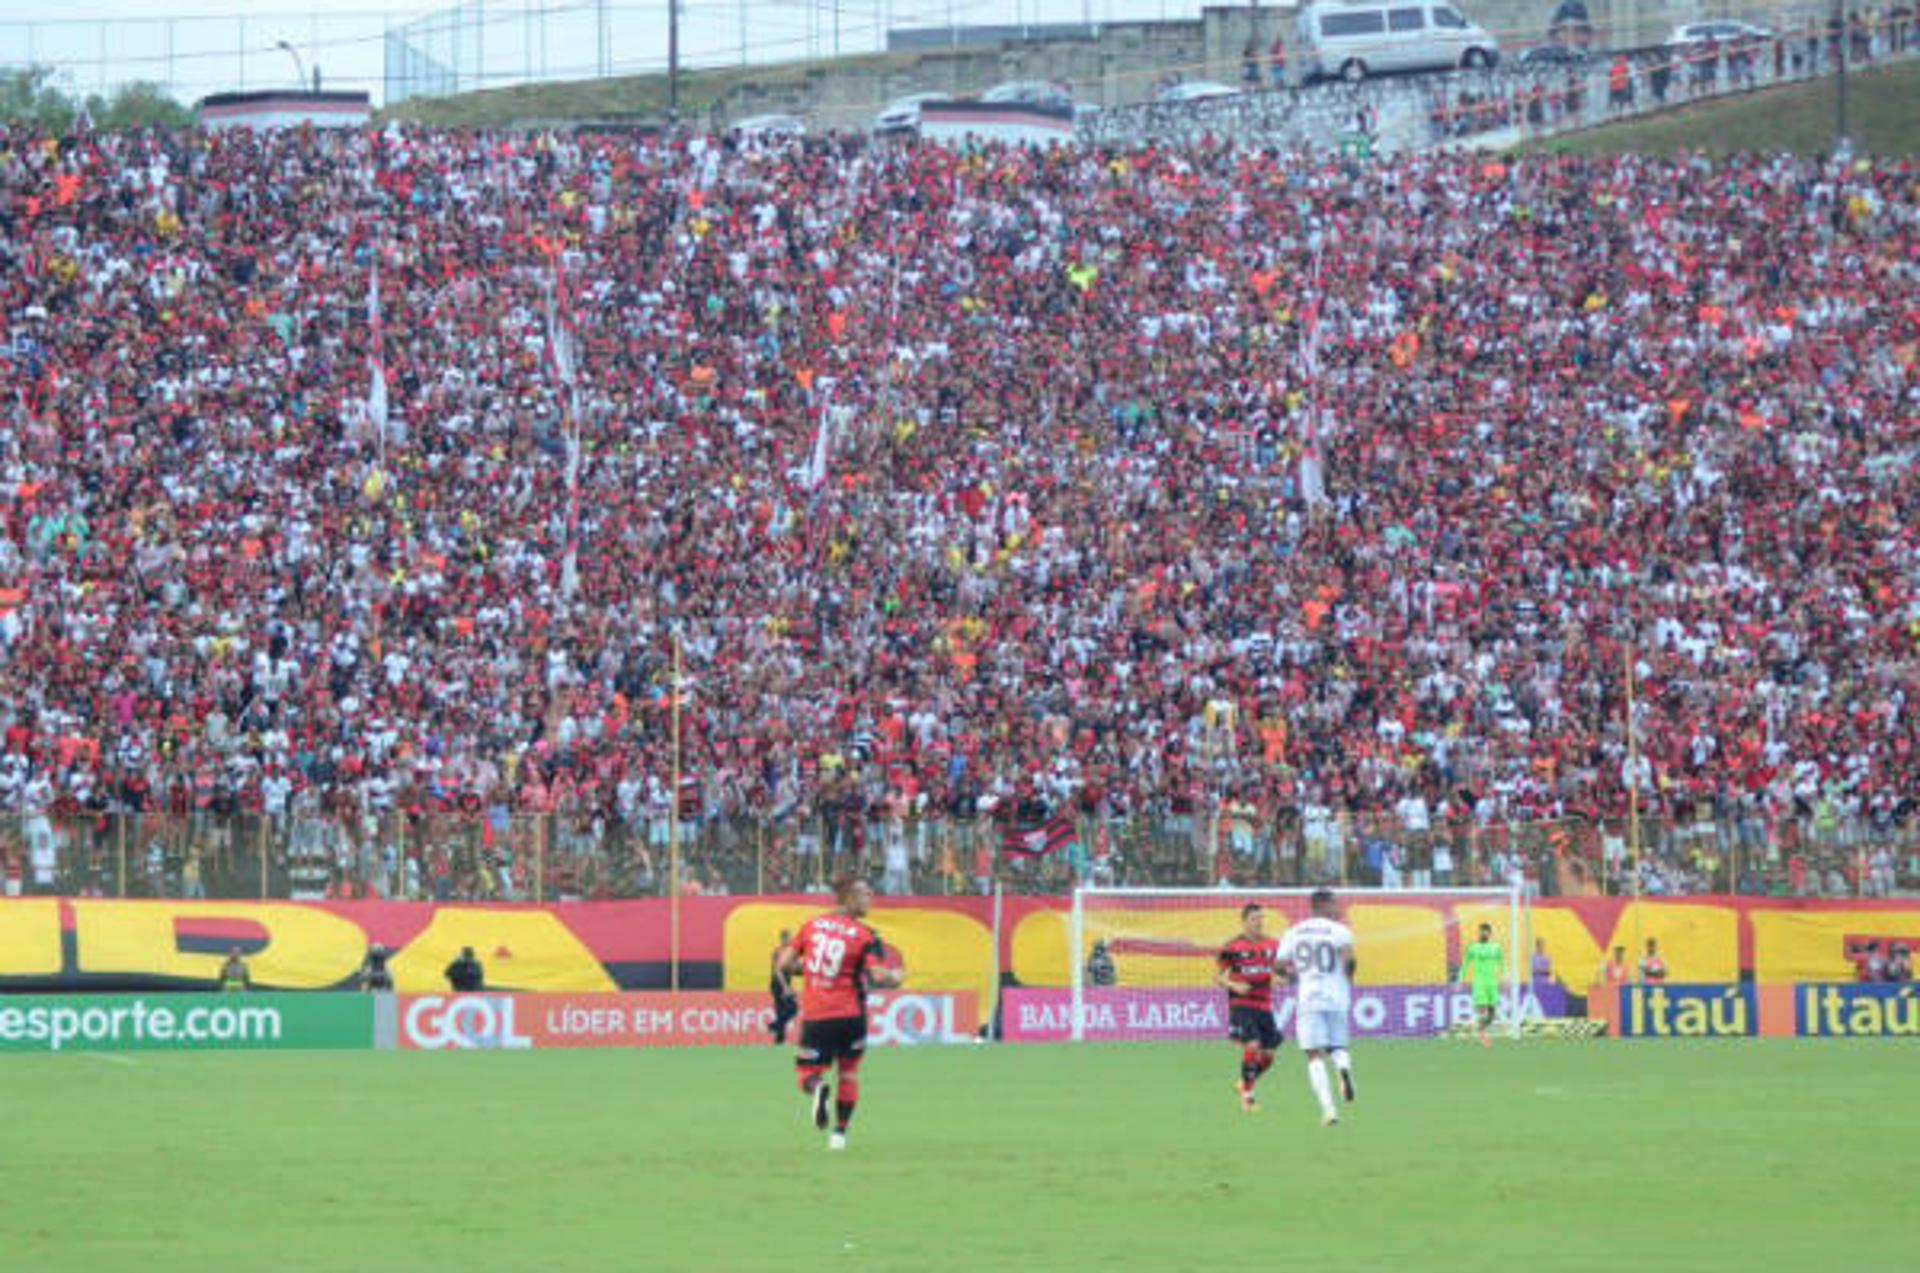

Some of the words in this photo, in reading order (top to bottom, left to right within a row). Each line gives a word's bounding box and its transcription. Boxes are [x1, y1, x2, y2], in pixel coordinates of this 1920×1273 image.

[807, 933, 845, 977] 39
[1295, 941, 1336, 973] 90
[0, 1000, 281, 1050] esporte.com
[405, 996, 532, 1049] GOL
[546, 1003, 624, 1034] LÍDER
[635, 1010, 673, 1034] EM
[681, 1010, 778, 1034] CONFO
[1126, 1000, 1221, 1029] LARGA
[1630, 986, 1747, 1035] Itaú
[1805, 986, 1920, 1035] Itaú
